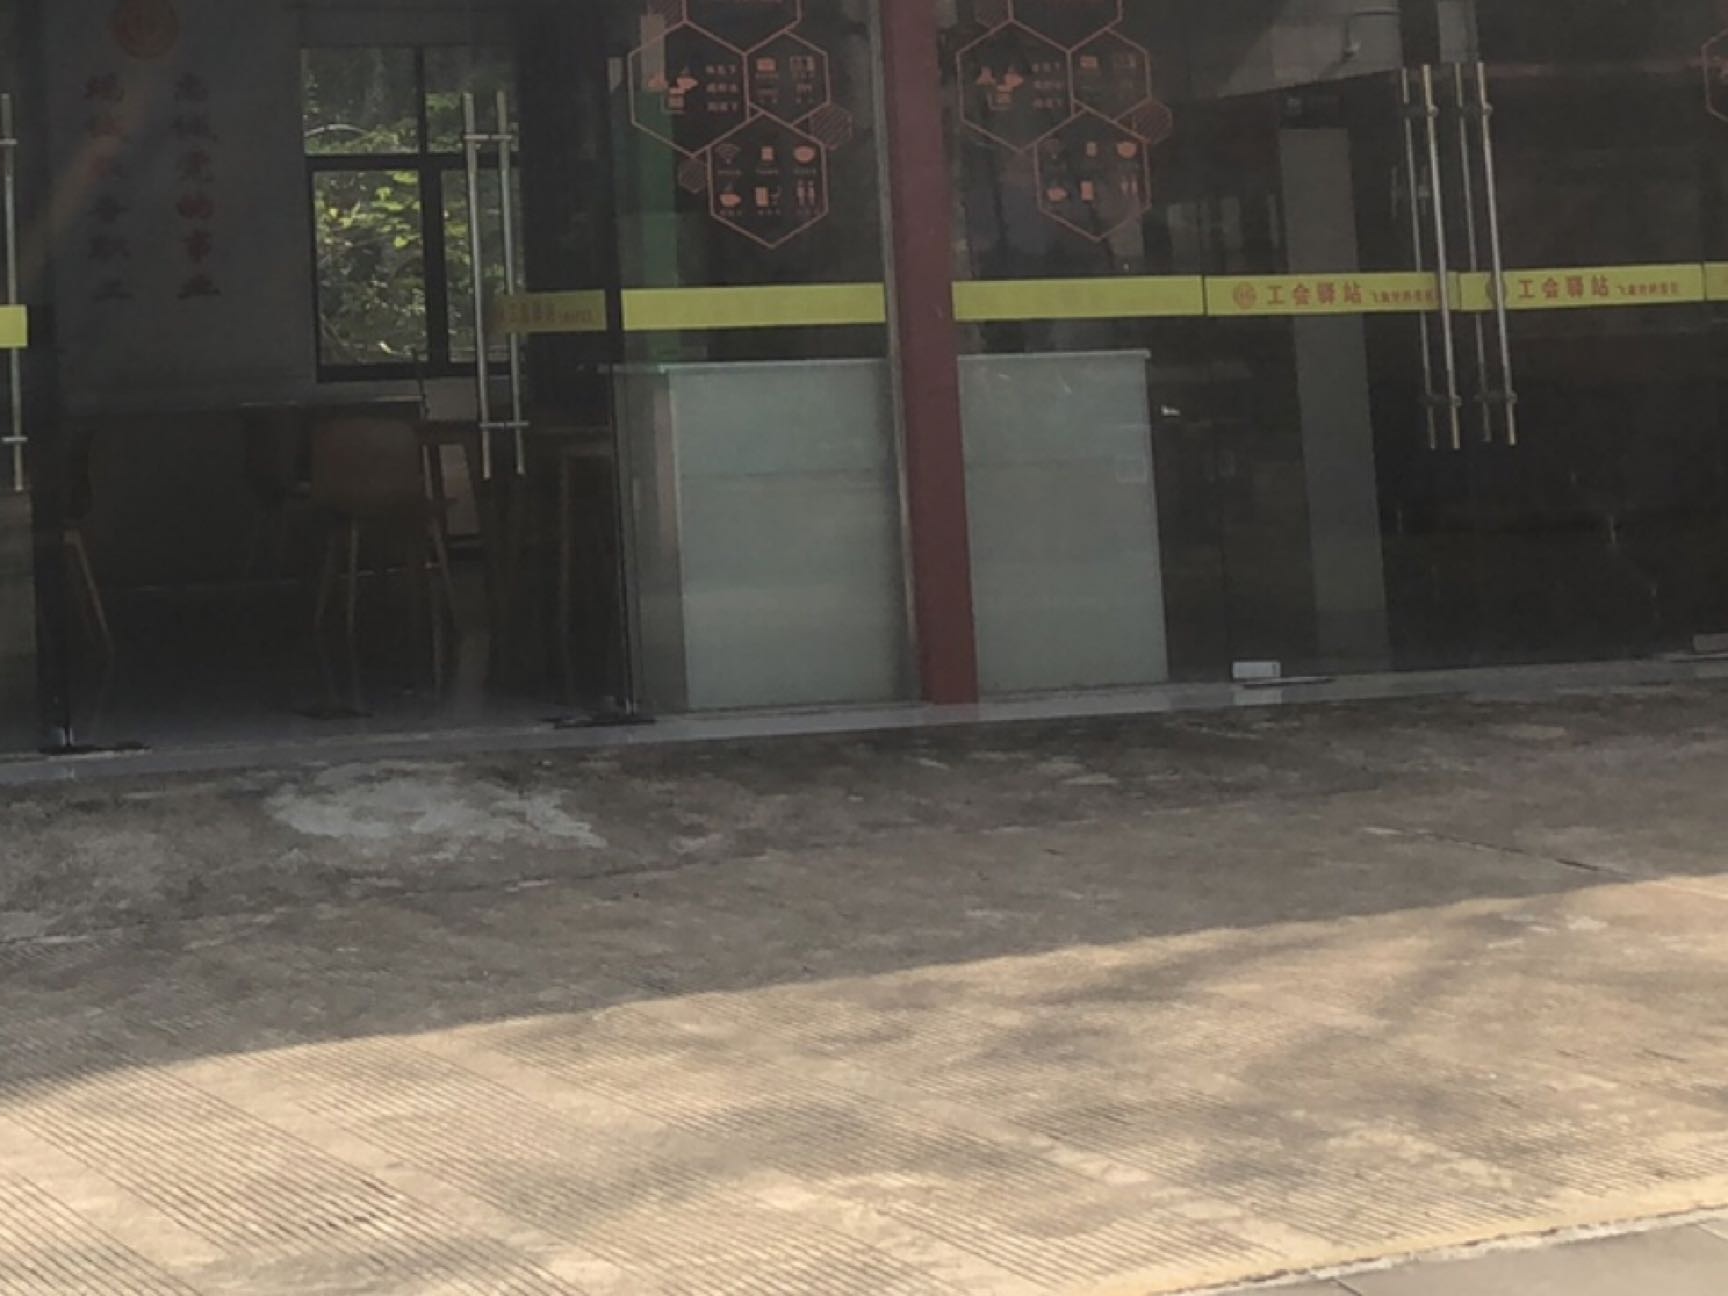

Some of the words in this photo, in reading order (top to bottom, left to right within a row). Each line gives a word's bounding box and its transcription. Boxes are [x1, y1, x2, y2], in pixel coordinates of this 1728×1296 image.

[1266, 280, 1364, 305] 工会驿站
[1518, 275, 1610, 300] 工会驿站
